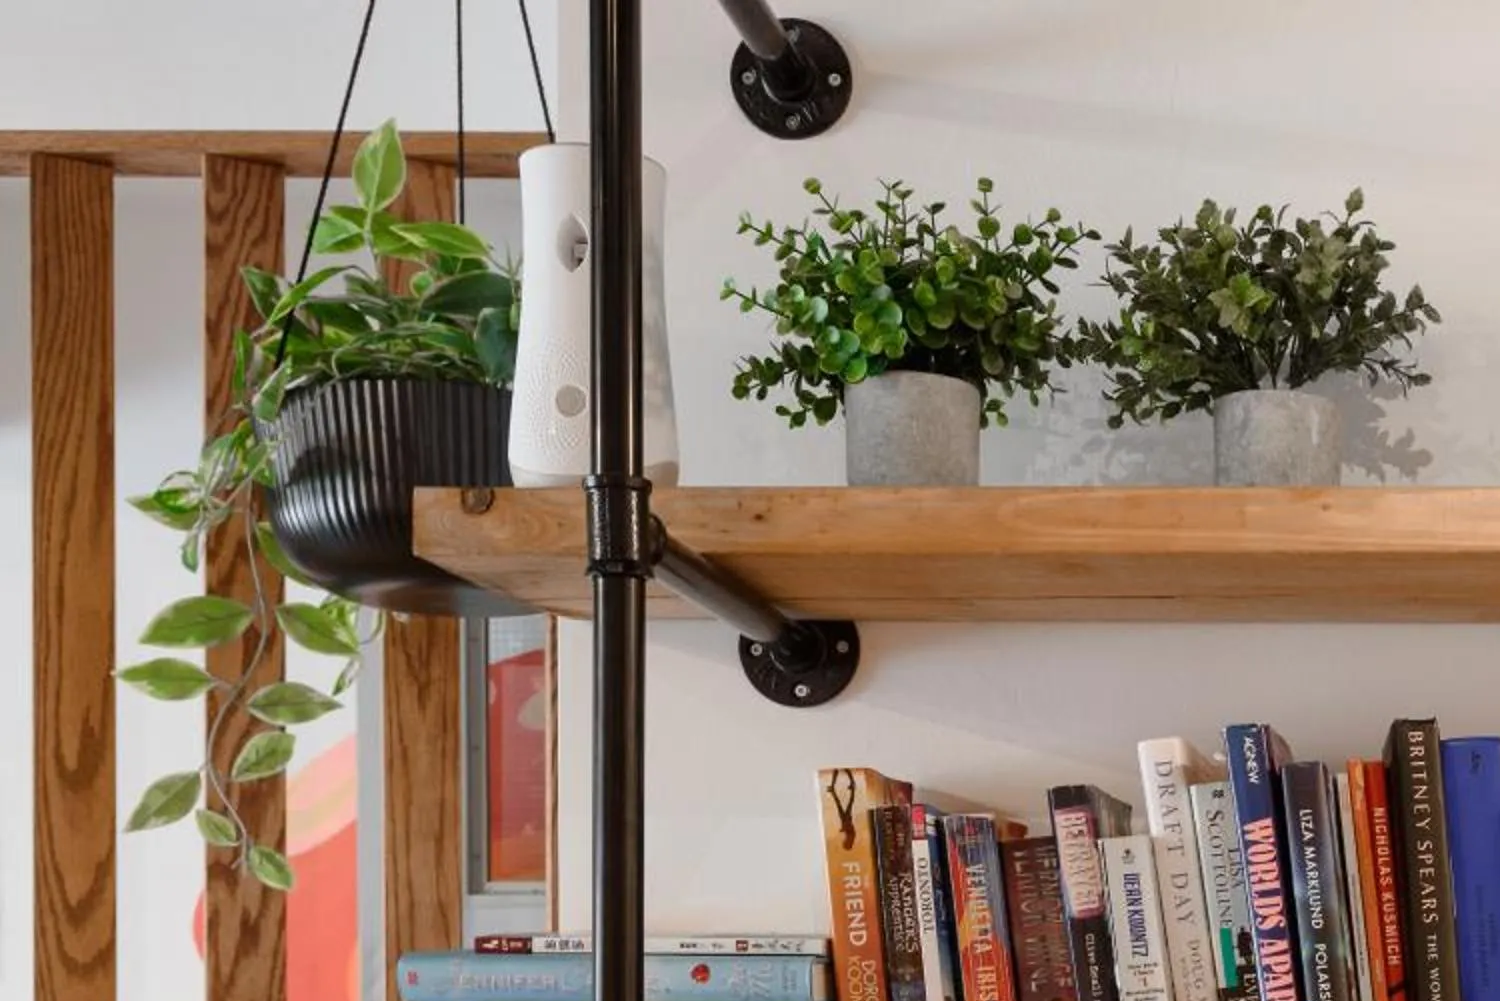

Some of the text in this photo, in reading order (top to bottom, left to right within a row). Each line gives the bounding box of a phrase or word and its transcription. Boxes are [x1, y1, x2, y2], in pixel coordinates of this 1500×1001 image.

[1242, 735, 1260, 784] AGNEW
[1407, 731, 1432, 829] BRITNEY
[1154, 760, 1195, 924] DRAFT DAY
[1205, 810, 1233, 928] SCOTTOLINE
[1228, 847, 1245, 889] LISA
[1243, 817, 1286, 931] WORLDS
[1299, 808, 1323, 929] LIZA MARKLUND
[1417, 840, 1439, 923] SPEARS
[842, 860, 868, 946] FRIEND
[917, 857, 935, 935] TORONTO
[965, 863, 994, 954] VENDETTA
[1123, 873, 1145, 907] DEAN
[1373, 806, 1400, 966] NICHOLAS KUSMICH
[1085, 933, 1098, 962] Clive
[1127, 908, 1149, 957] KOONTZ
[1188, 940, 1205, 989] DOUG
[1427, 932, 1438, 961] THE
[975, 965, 996, 1001] IRIS
